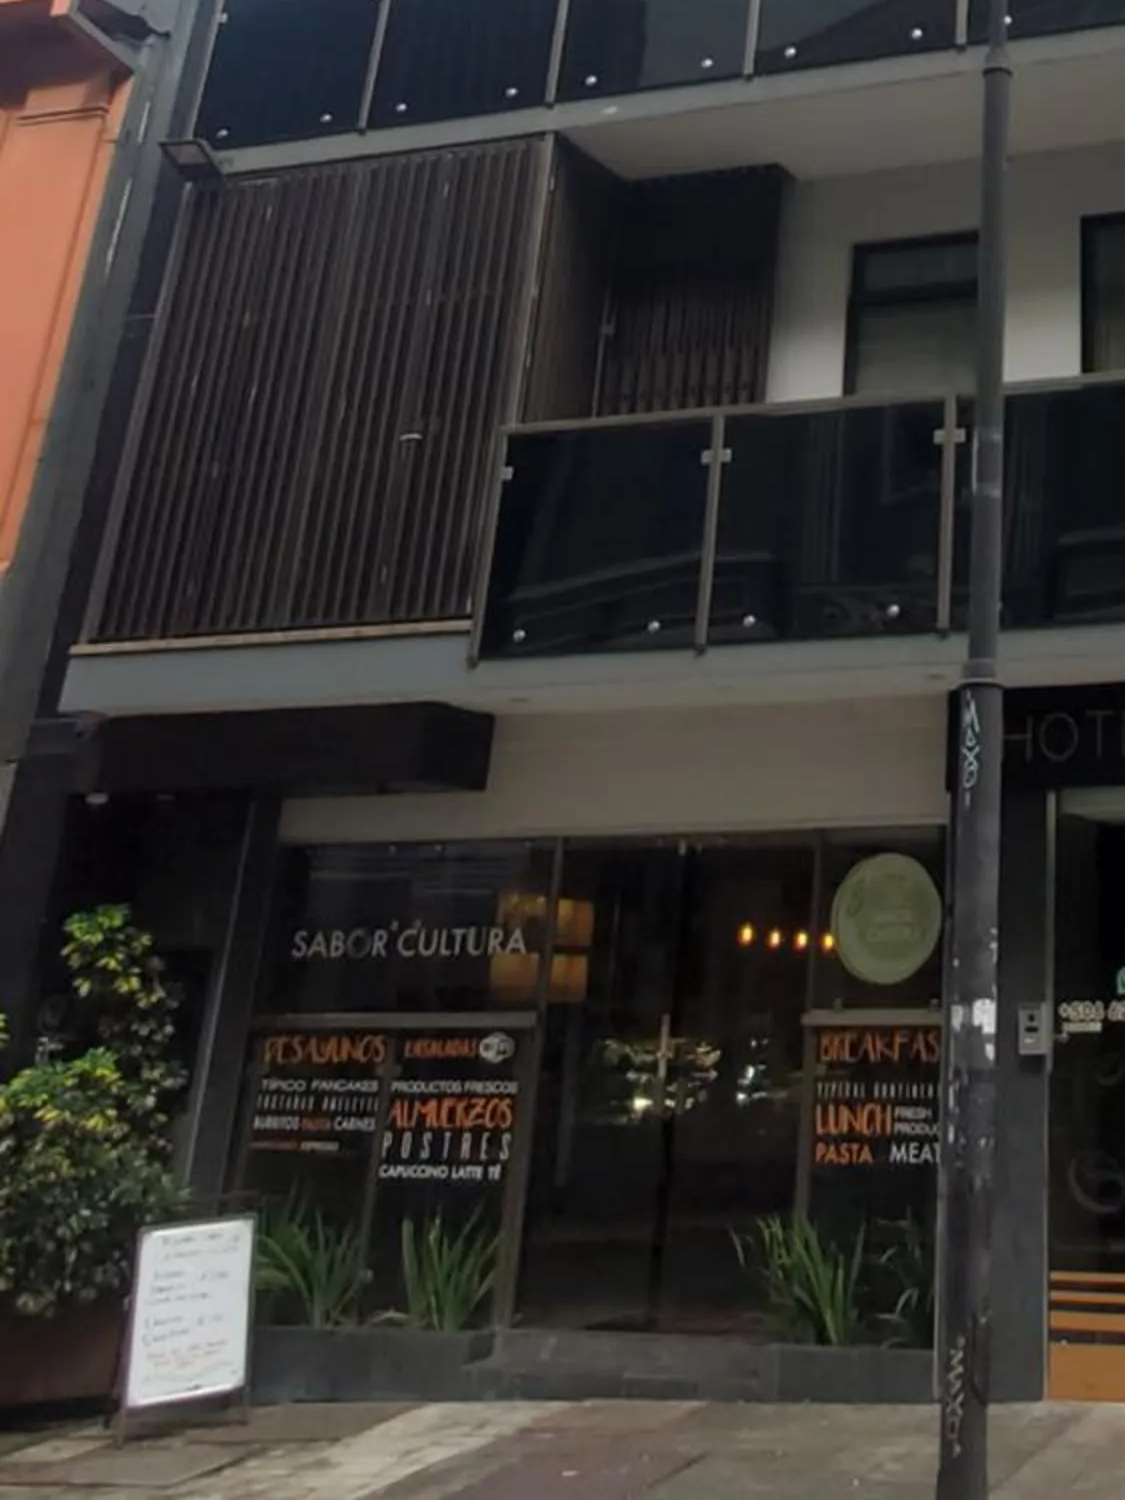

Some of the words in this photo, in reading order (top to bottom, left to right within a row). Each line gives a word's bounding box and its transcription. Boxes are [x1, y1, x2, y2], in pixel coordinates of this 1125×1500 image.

[291, 927, 389, 959] SABOR
[396, 925, 528, 958] CULTURA
[819, 1030, 941, 1064] BREAKFAS
[815, 1102, 893, 1137] LUNCH
[380, 1130, 512, 1162] POSTRES
[814, 1141, 874, 1165] PASTA
[451, 1164, 485, 1181] LATTE
